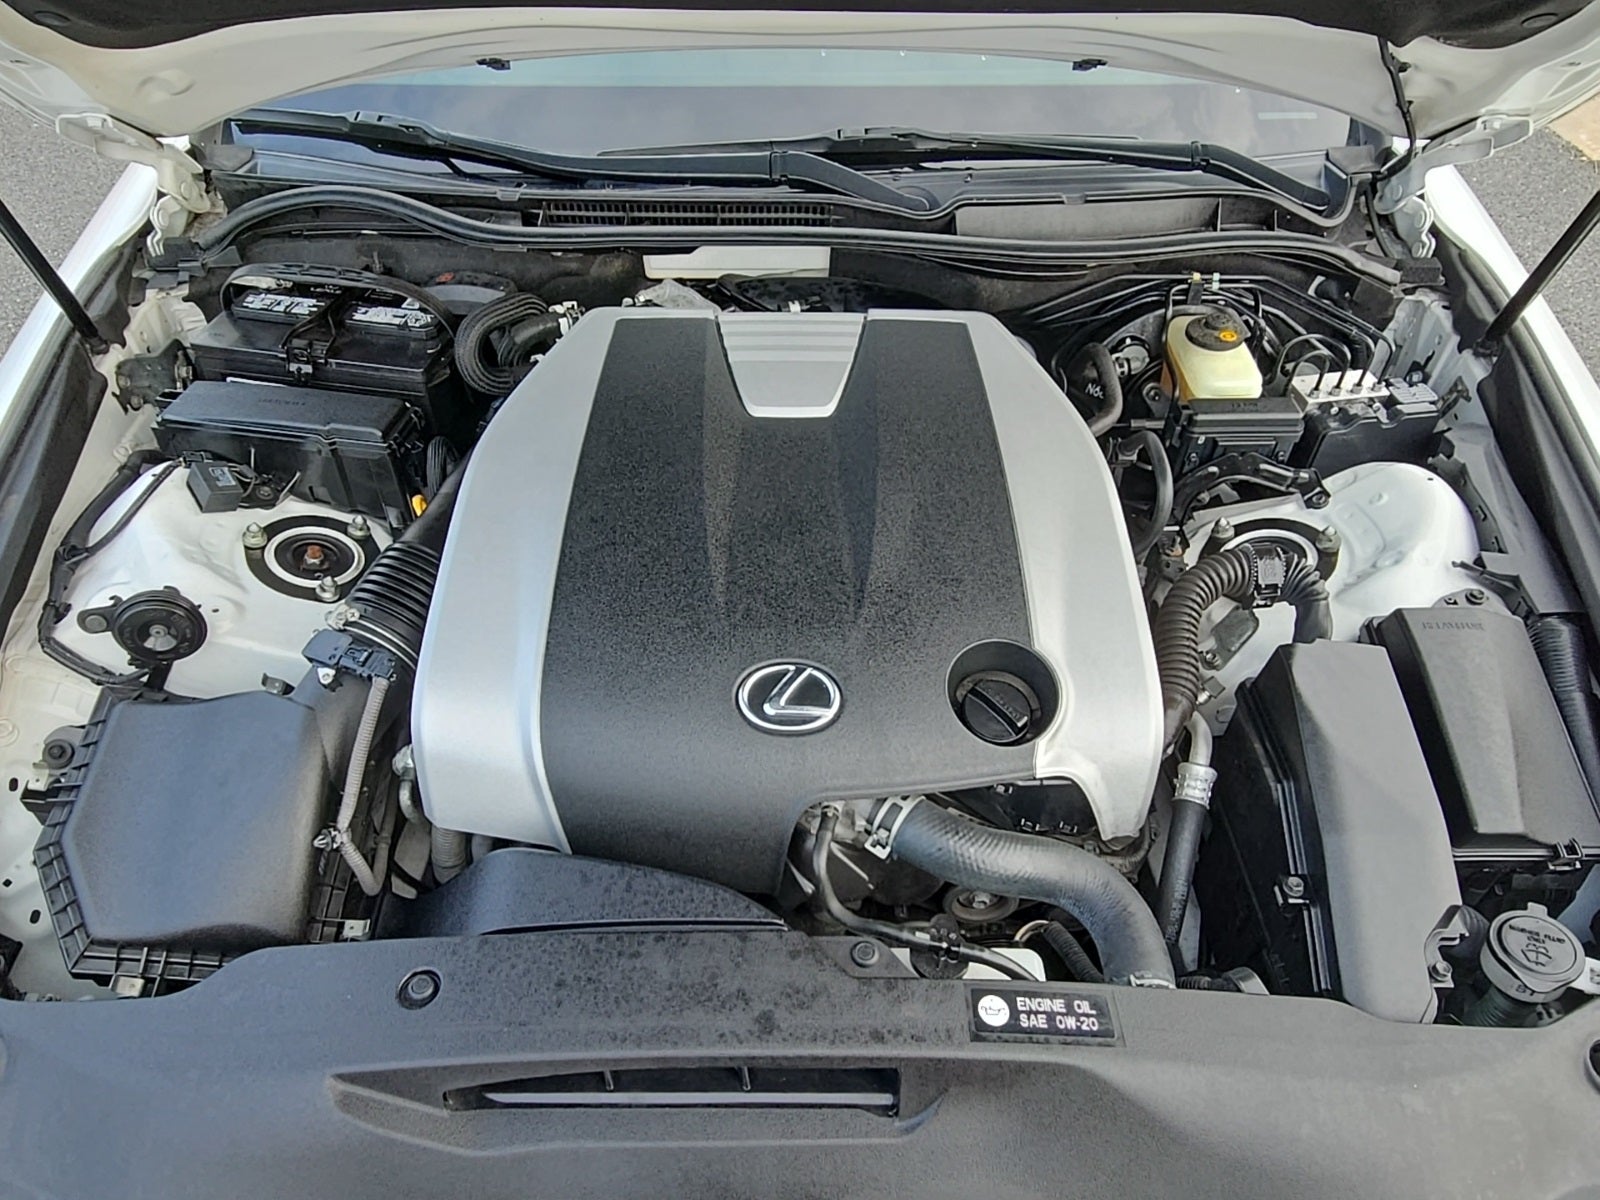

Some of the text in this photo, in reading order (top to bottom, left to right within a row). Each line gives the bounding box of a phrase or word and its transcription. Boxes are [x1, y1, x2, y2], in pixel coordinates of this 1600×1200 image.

[1016, 997, 1097, 1014] ENGINE OIL
[1020, 1013, 1099, 1031] SAE 0W-20
